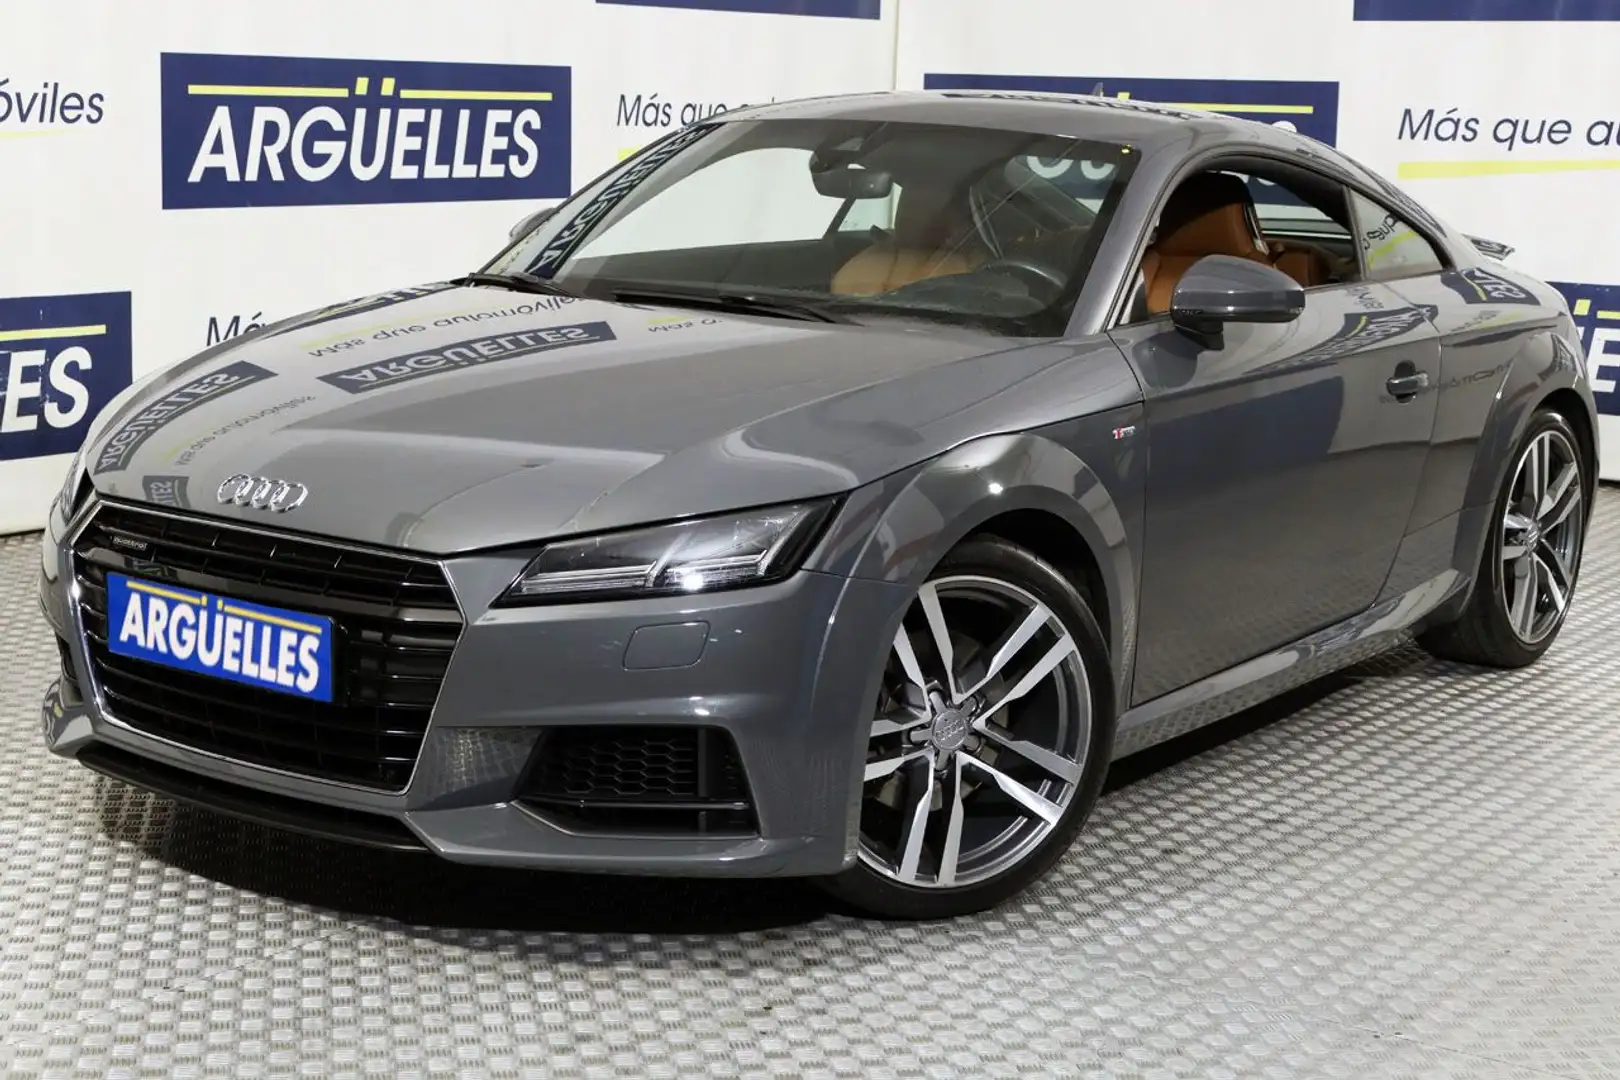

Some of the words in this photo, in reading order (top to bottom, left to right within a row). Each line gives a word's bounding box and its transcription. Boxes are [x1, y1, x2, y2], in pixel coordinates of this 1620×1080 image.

[187, 77, 541, 183] ARGÜELLES
[617, 93, 672, 127] Más
[1398, 108, 1480, 142] Más
[1493, 118, 1572, 152] que
[119, 591, 321, 693] ARGÜELLES
